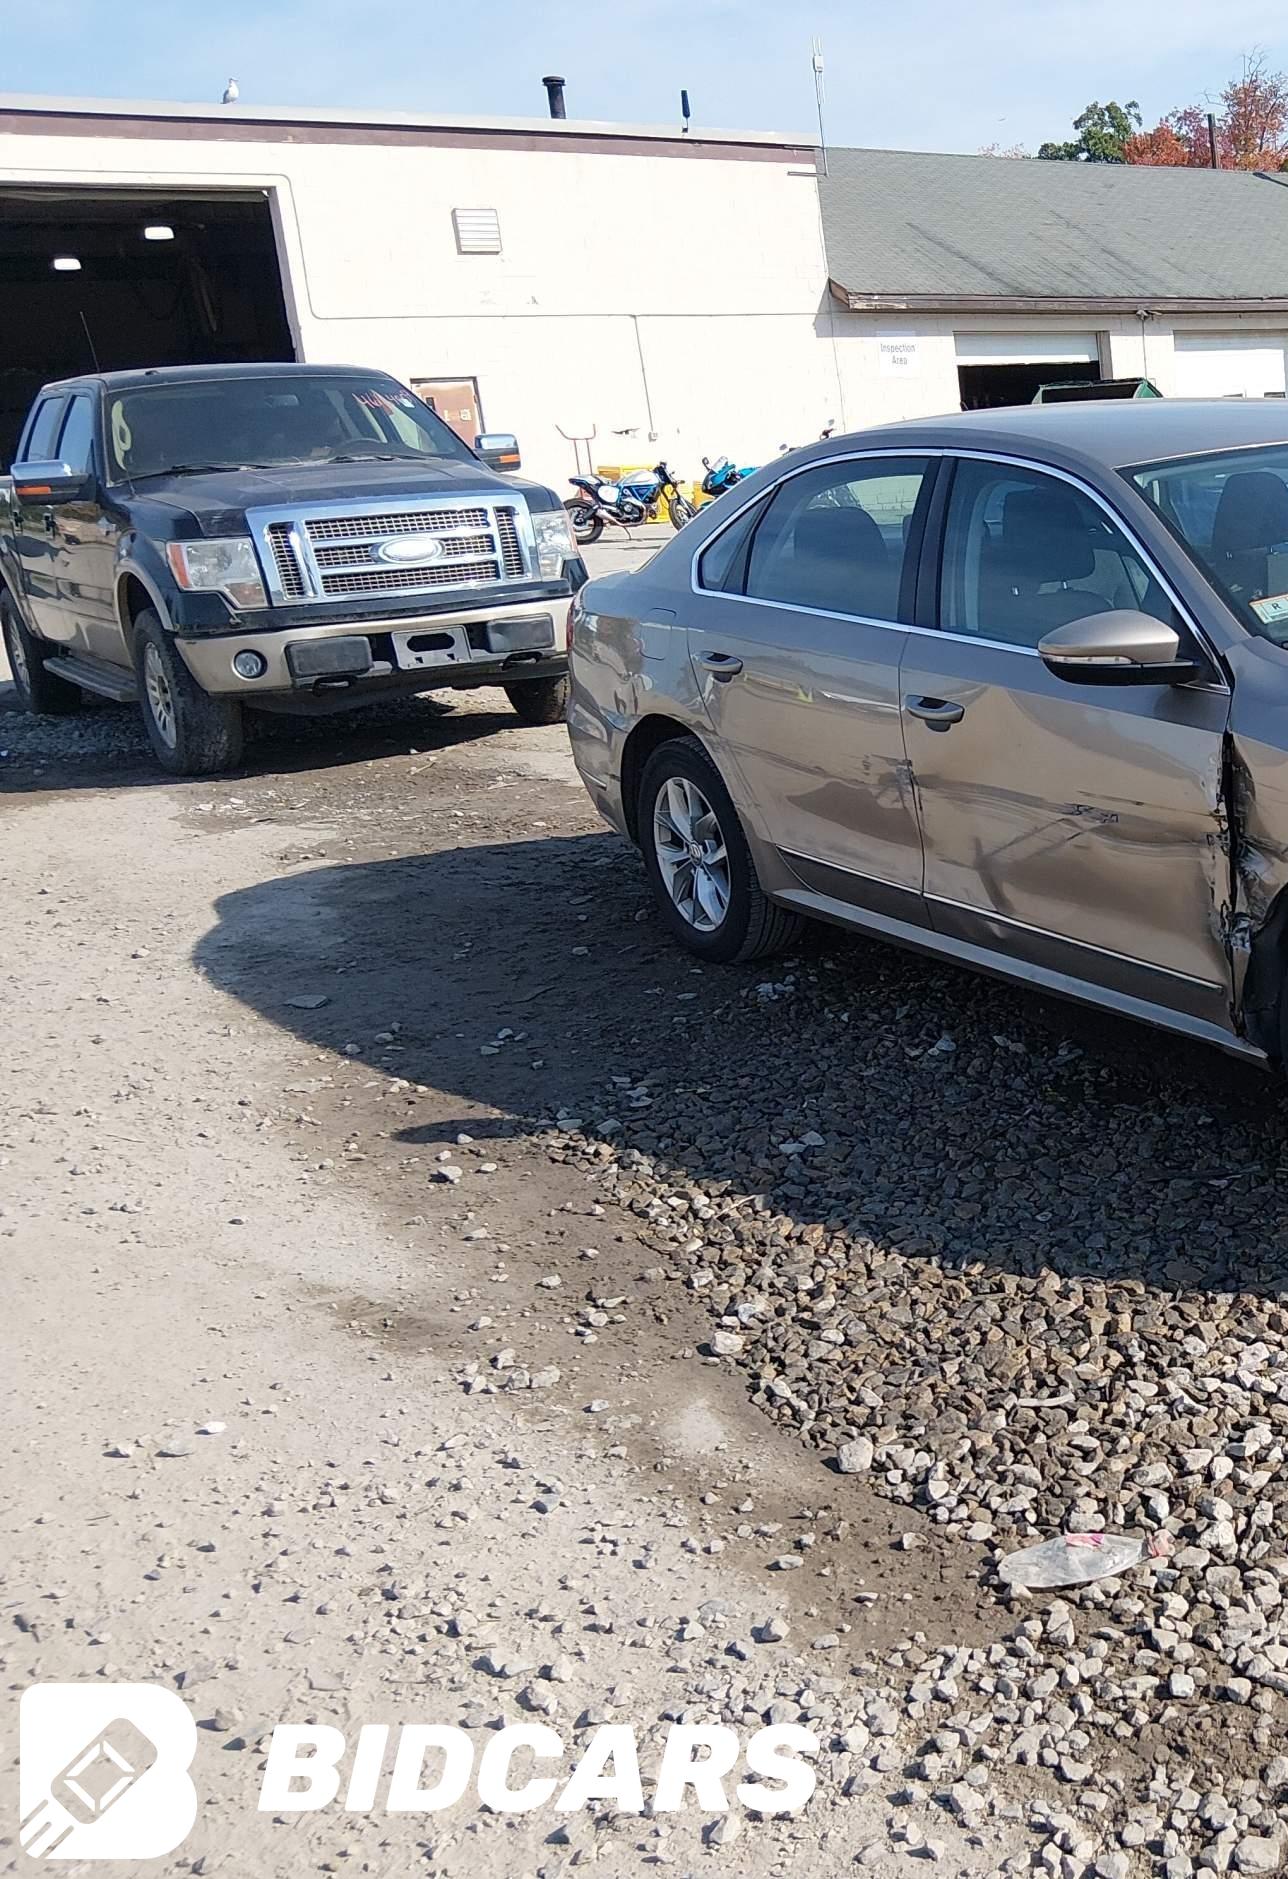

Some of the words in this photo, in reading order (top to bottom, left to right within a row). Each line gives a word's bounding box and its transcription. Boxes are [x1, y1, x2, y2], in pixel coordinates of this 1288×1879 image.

[880, 343, 916, 353] Inspection
[891, 354, 908, 365] Area
[1271, 602, 1281, 610] R
